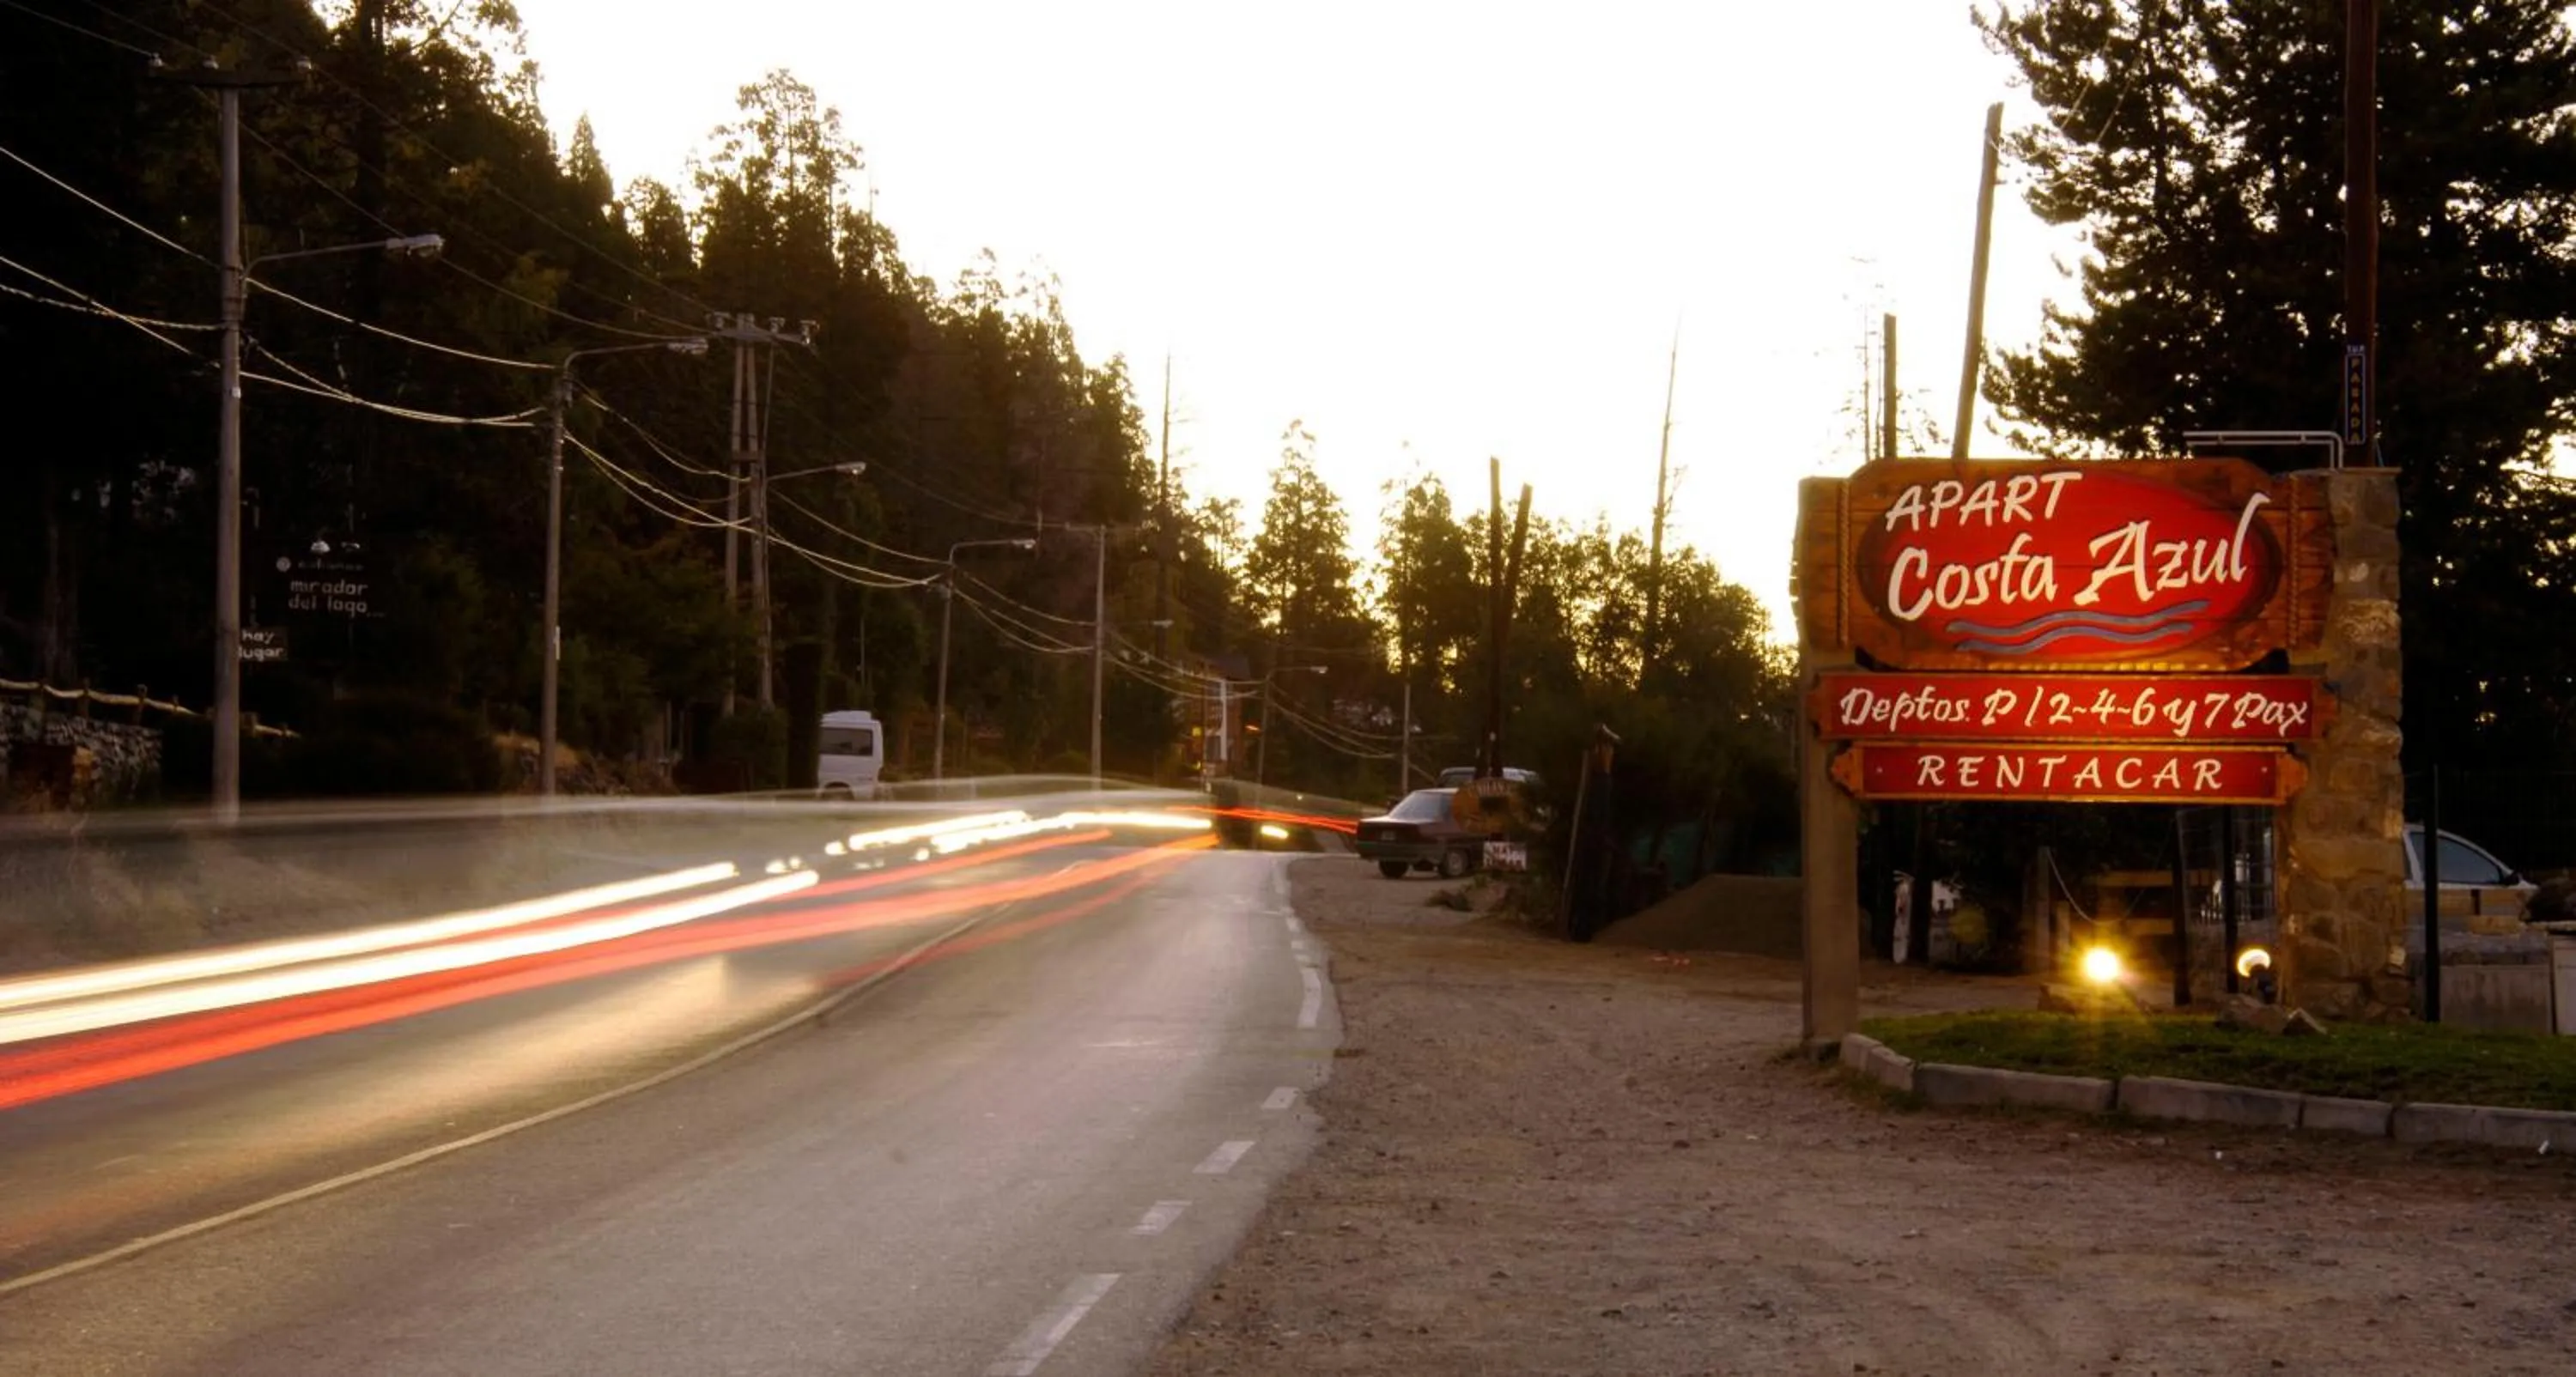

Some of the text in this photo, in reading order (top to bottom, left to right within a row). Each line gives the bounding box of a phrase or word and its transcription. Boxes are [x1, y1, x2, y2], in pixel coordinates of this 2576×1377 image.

[1886, 471, 2082, 531] APART
[1892, 492, 2270, 621] Costa Azul
[1840, 685, 1970, 731] Deptos.
[2232, 692, 2307, 737] Pax
